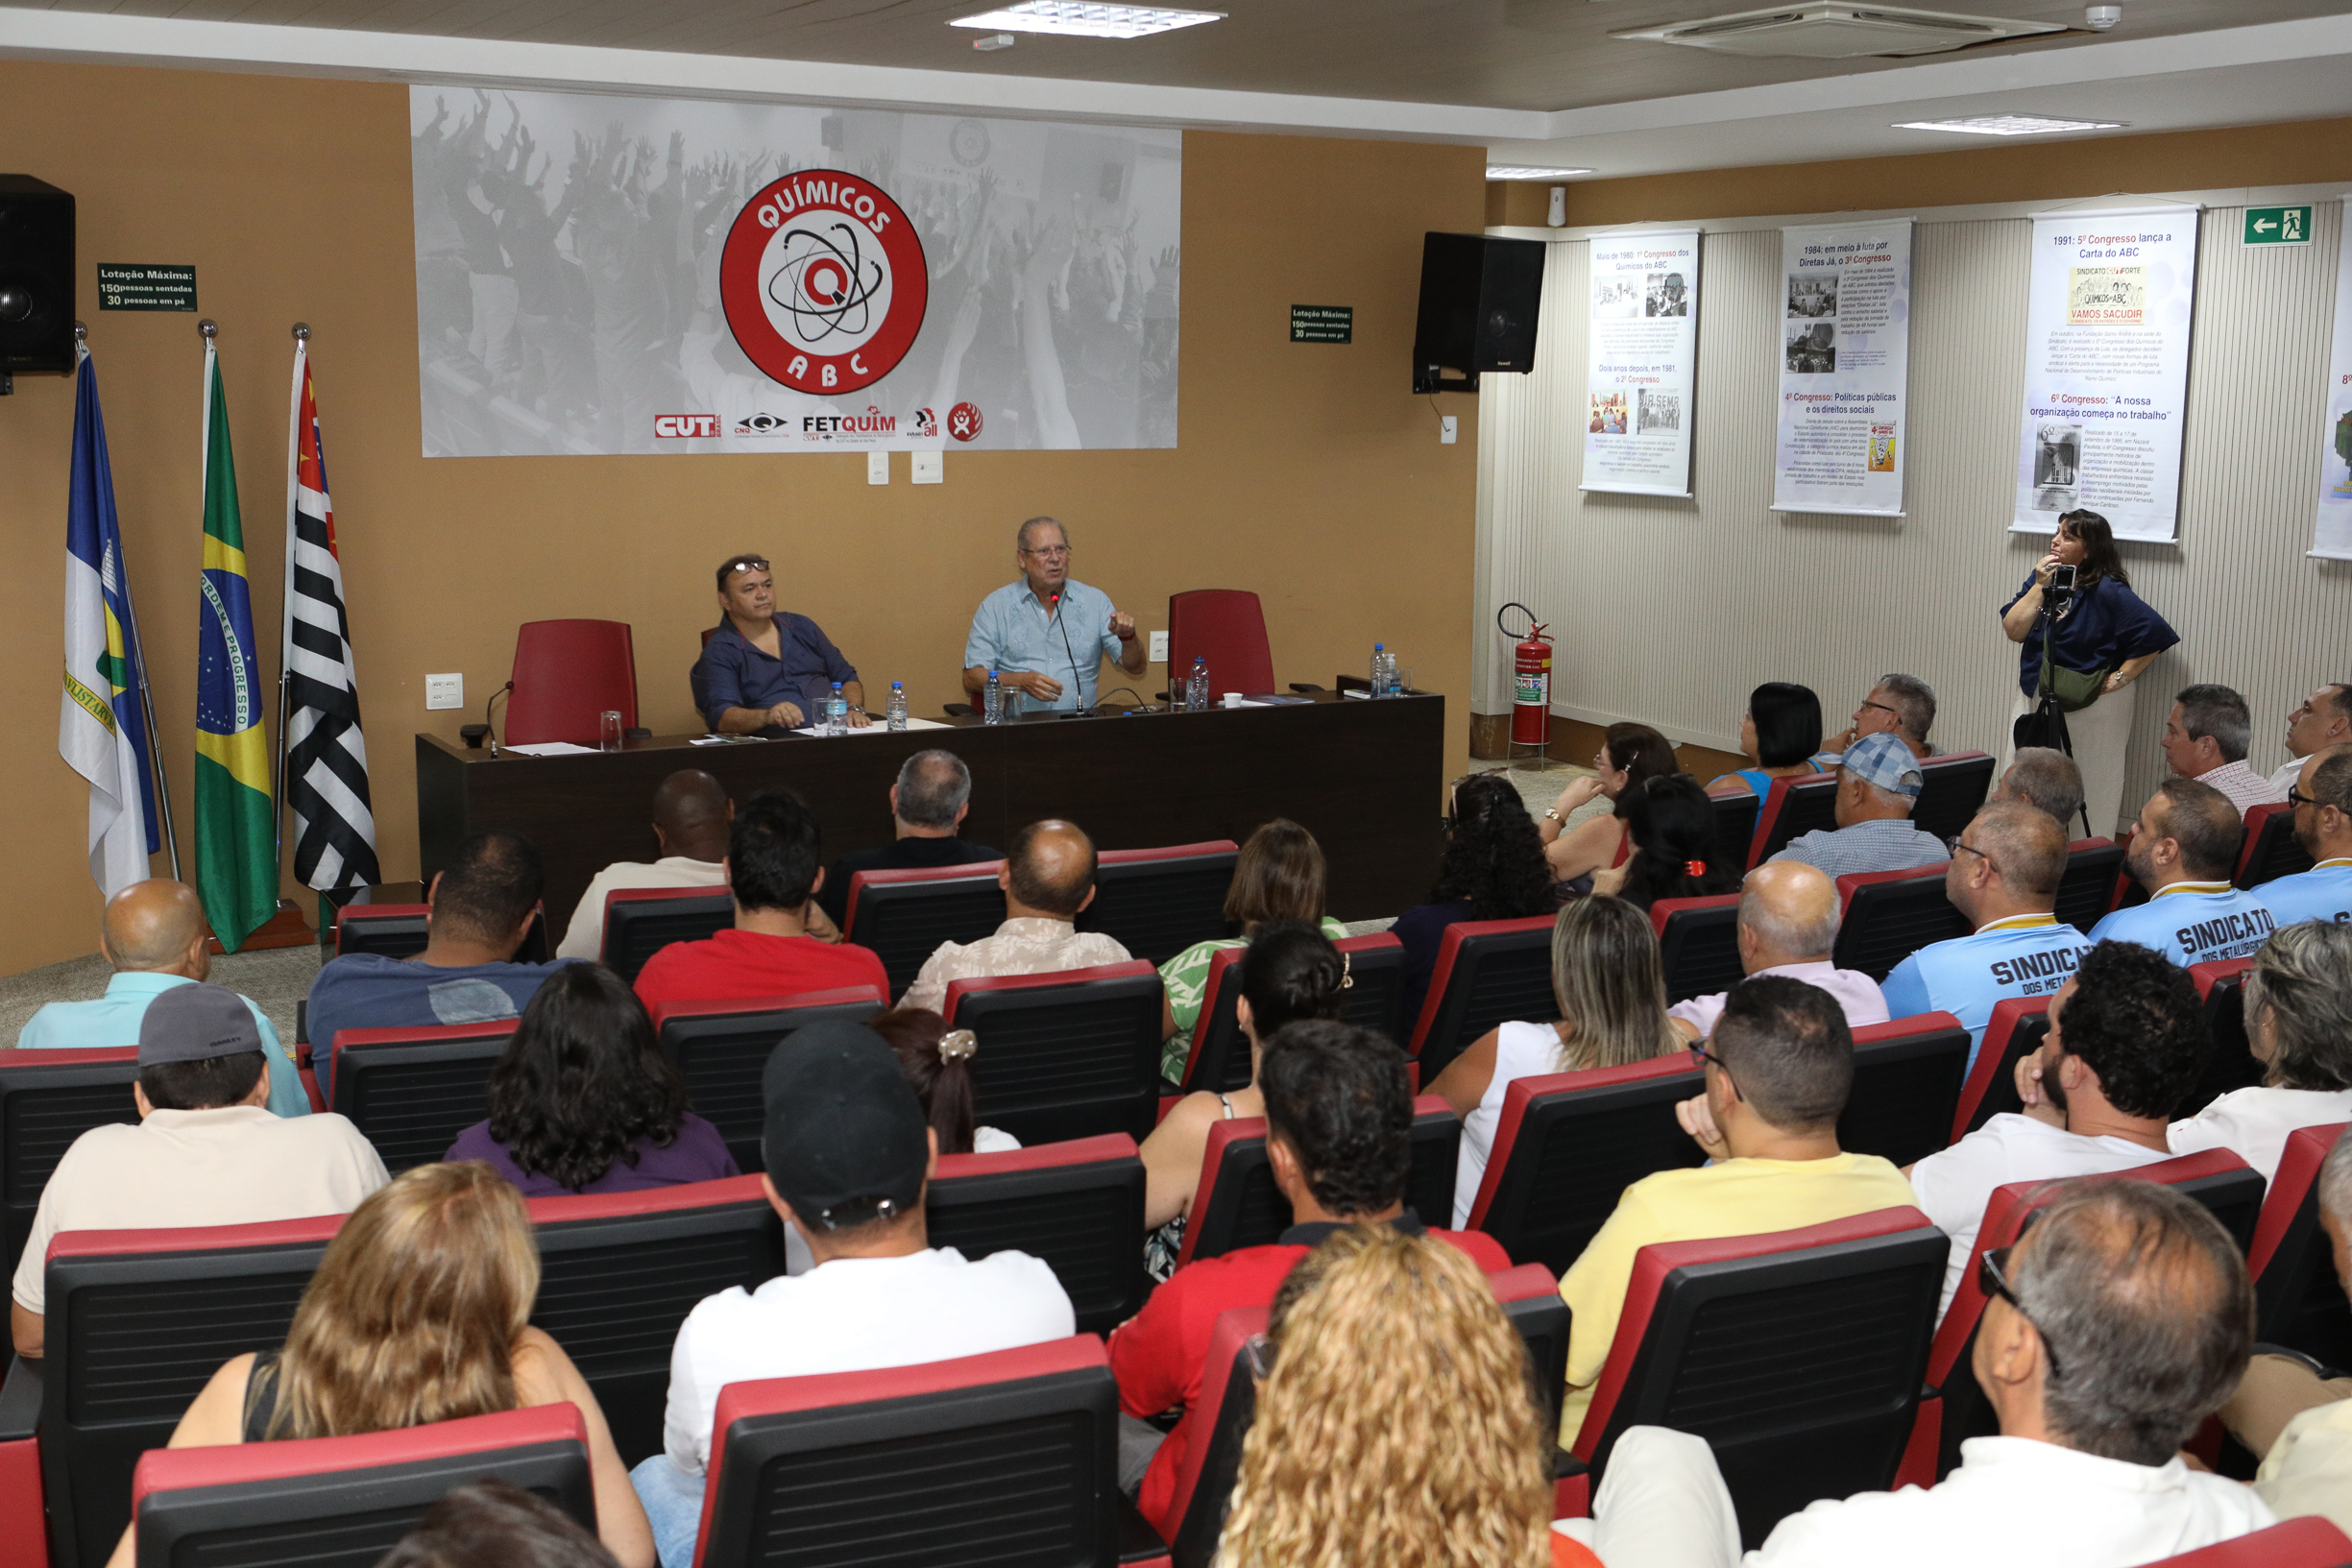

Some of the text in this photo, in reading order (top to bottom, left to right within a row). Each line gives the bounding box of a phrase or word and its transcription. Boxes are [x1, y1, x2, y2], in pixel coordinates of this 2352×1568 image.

[758, 176, 891, 233] QUÍMICOS
[2054, 236, 2075, 245] 1991:
[2078, 235, 2086, 244] 5º
[2088, 234, 2136, 246] Congresso
[2139, 233, 2163, 244] lança
[1837, 244, 1854, 253] meio
[1862, 242, 1874, 250] luta
[1876, 241, 1887, 251] por
[2080, 247, 2139, 258] Carta do ABC
[1644, 250, 1676, 259] Congresso
[1800, 258, 1824, 267] Diretas
[1826, 257, 1837, 266] Já,
[1845, 256, 1852, 264] 3º
[1853, 254, 1891, 265] Congresso
[101, 270, 192, 280] Lotação Máxima:
[107, 295, 121, 305] 30
[2113, 294, 2126, 304] ABC
[1293, 309, 1320, 319] Lotação
[2072, 310, 2142, 318] VAMOS SACUDIR
[1629, 365, 1650, 373] depois,
[1662, 365, 1677, 373] 1981,
[1628, 376, 1660, 384] Congresso
[1794, 393, 1833, 402] Congresso:
[1835, 393, 1865, 401] Políticas
[1867, 392, 1896, 403] públicas
[2051, 394, 2060, 403] 6º
[2062, 394, 2108, 405] Congresso:
[1821, 405, 1847, 413] direitos
[2030, 408, 2080, 419] organização
[2082, 410, 2114, 420] começa
[655, 417, 714, 437] CUT
[200, 577, 226, 622] ORDEM
[227, 636, 247, 724] PROGRESSO
[2176, 908, 2275, 954] SINDICATO
[2022, 982, 2042, 995] DOS
